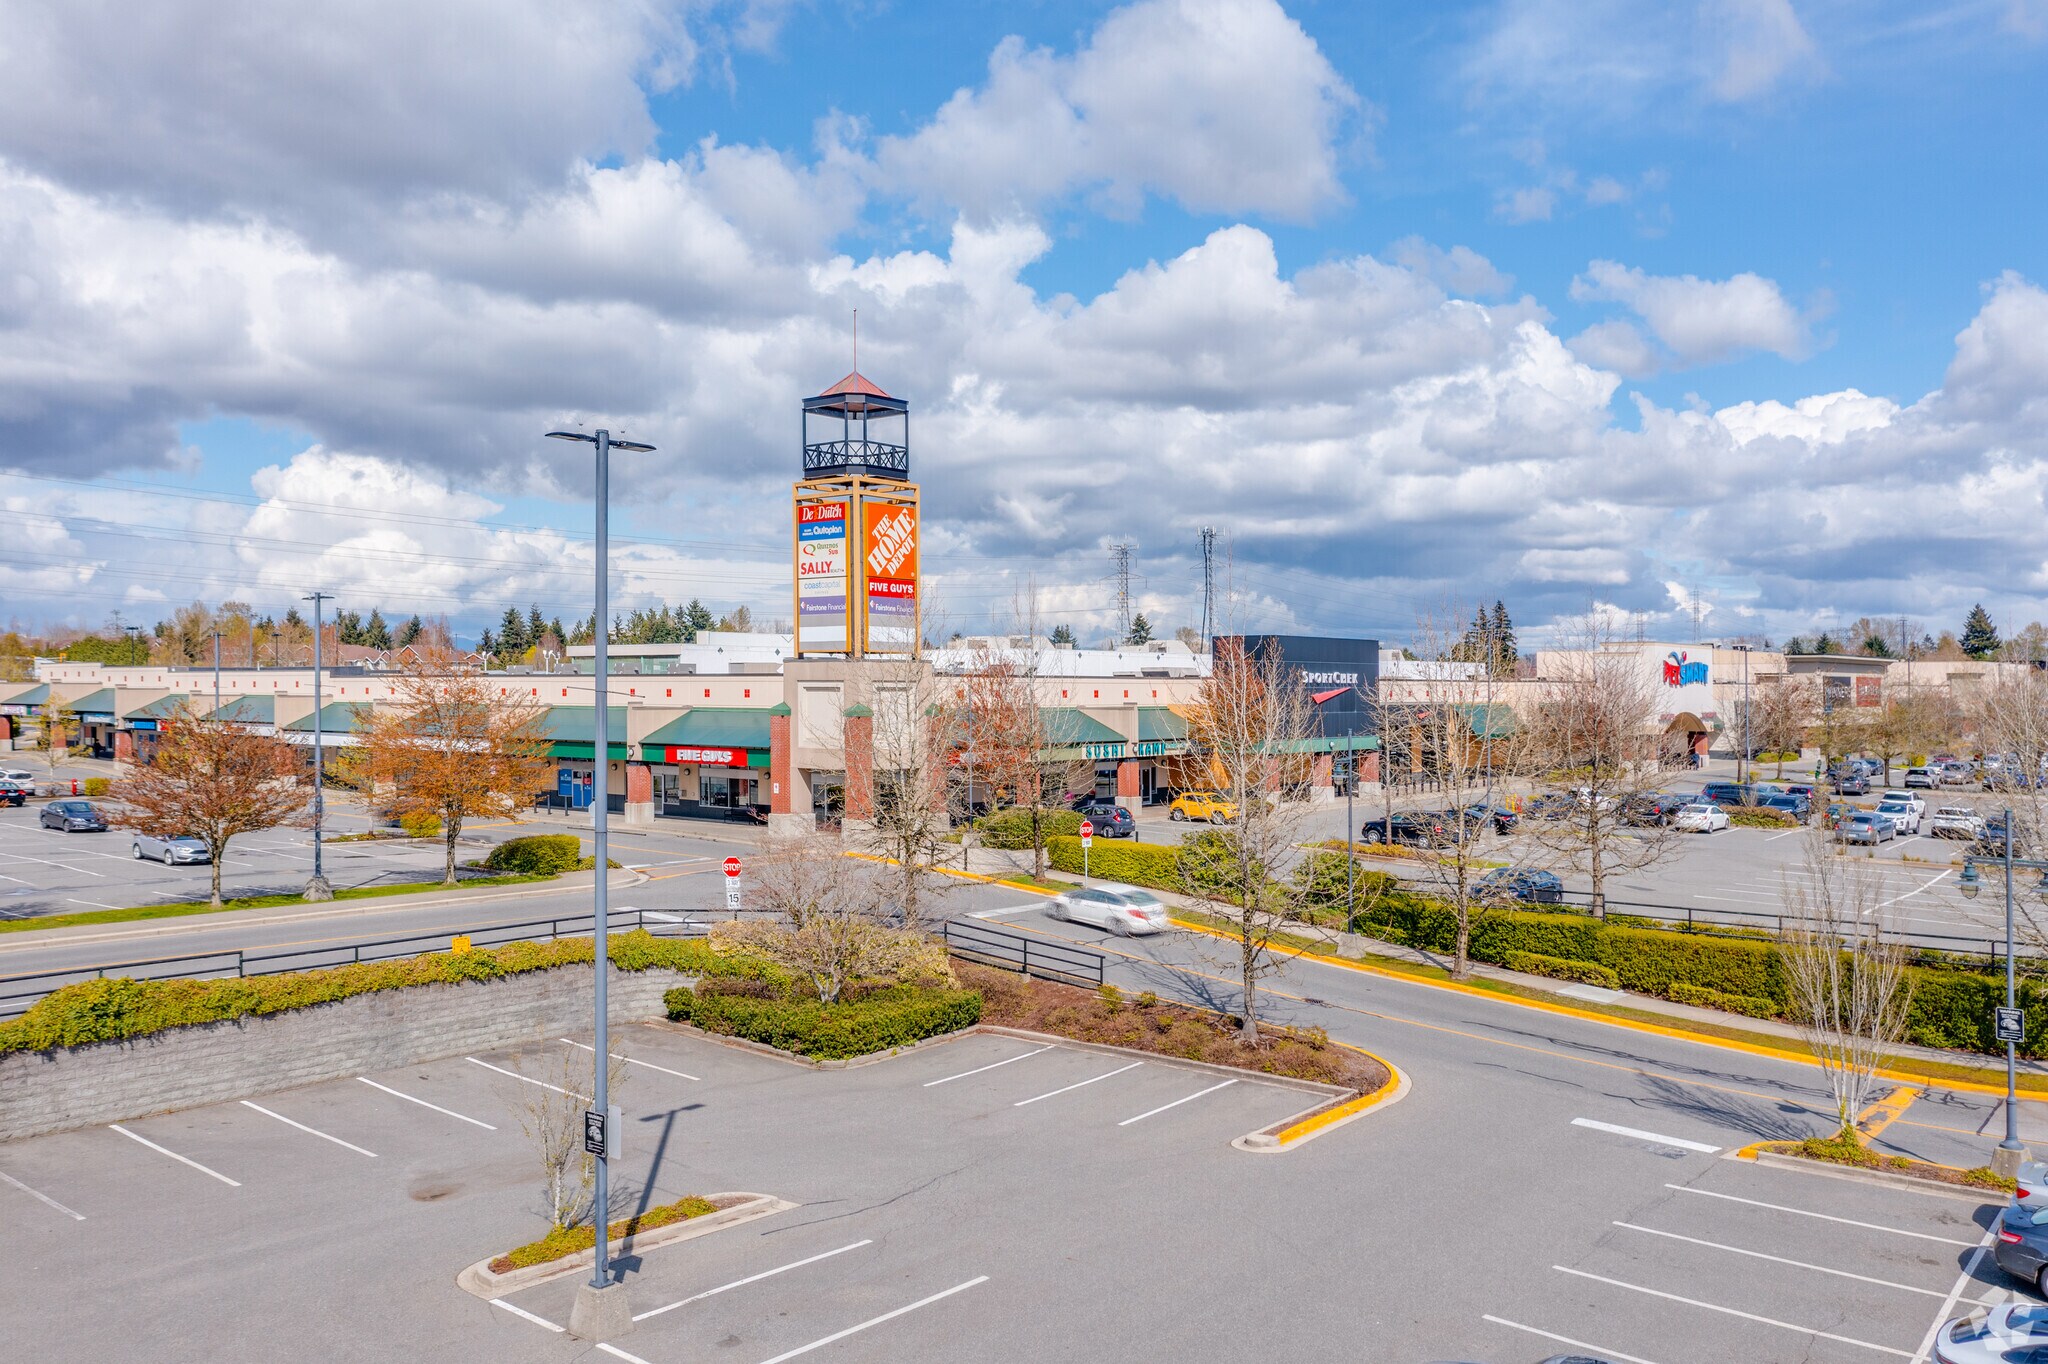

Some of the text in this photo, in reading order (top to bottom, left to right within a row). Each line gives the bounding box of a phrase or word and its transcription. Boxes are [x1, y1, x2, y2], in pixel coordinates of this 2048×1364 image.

[802, 504, 842, 521] De Dutch
[872, 514, 892, 540] THE
[868, 508, 915, 575] HOME
[886, 534, 915, 576] DEPOT
[800, 561, 832, 575] SALLY
[870, 582, 914, 593] FIVE GUYS
[875, 603, 896, 612] Fairstone
[677, 750, 732, 762] FIVE GUYS
[1086, 744, 1126, 758] SUSHI
[724, 863, 741, 871] STOP
[729, 893, 739, 903] 15
